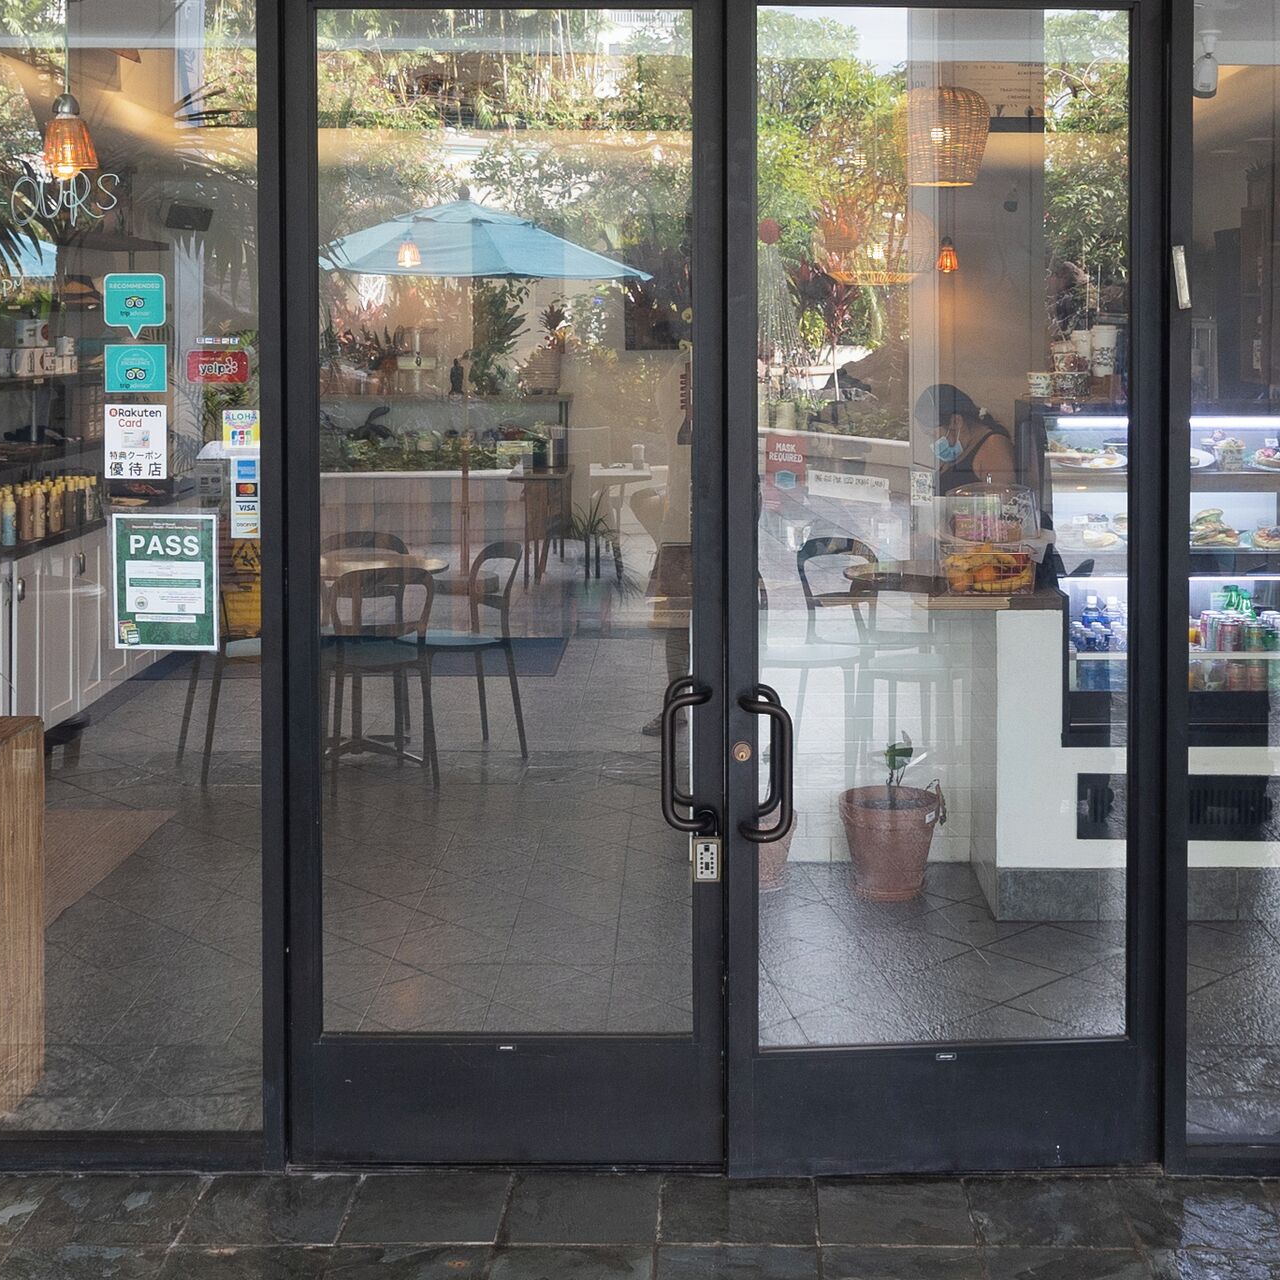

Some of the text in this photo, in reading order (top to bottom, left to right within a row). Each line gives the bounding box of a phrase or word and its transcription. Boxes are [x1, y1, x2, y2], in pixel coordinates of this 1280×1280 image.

[108, 282, 161, 290] RECOMMENDED
[199, 361, 226, 377] yelp
[117, 407, 162, 418] Rakuten
[225, 412, 258, 421] ALOHA
[118, 418, 143, 428] Card
[775, 442, 797, 453] MASK
[768, 451, 803, 463] REQUIRED
[109, 461, 163, 477] 優待店
[239, 504, 256, 512] VISA
[129, 534, 200, 556] PASS
